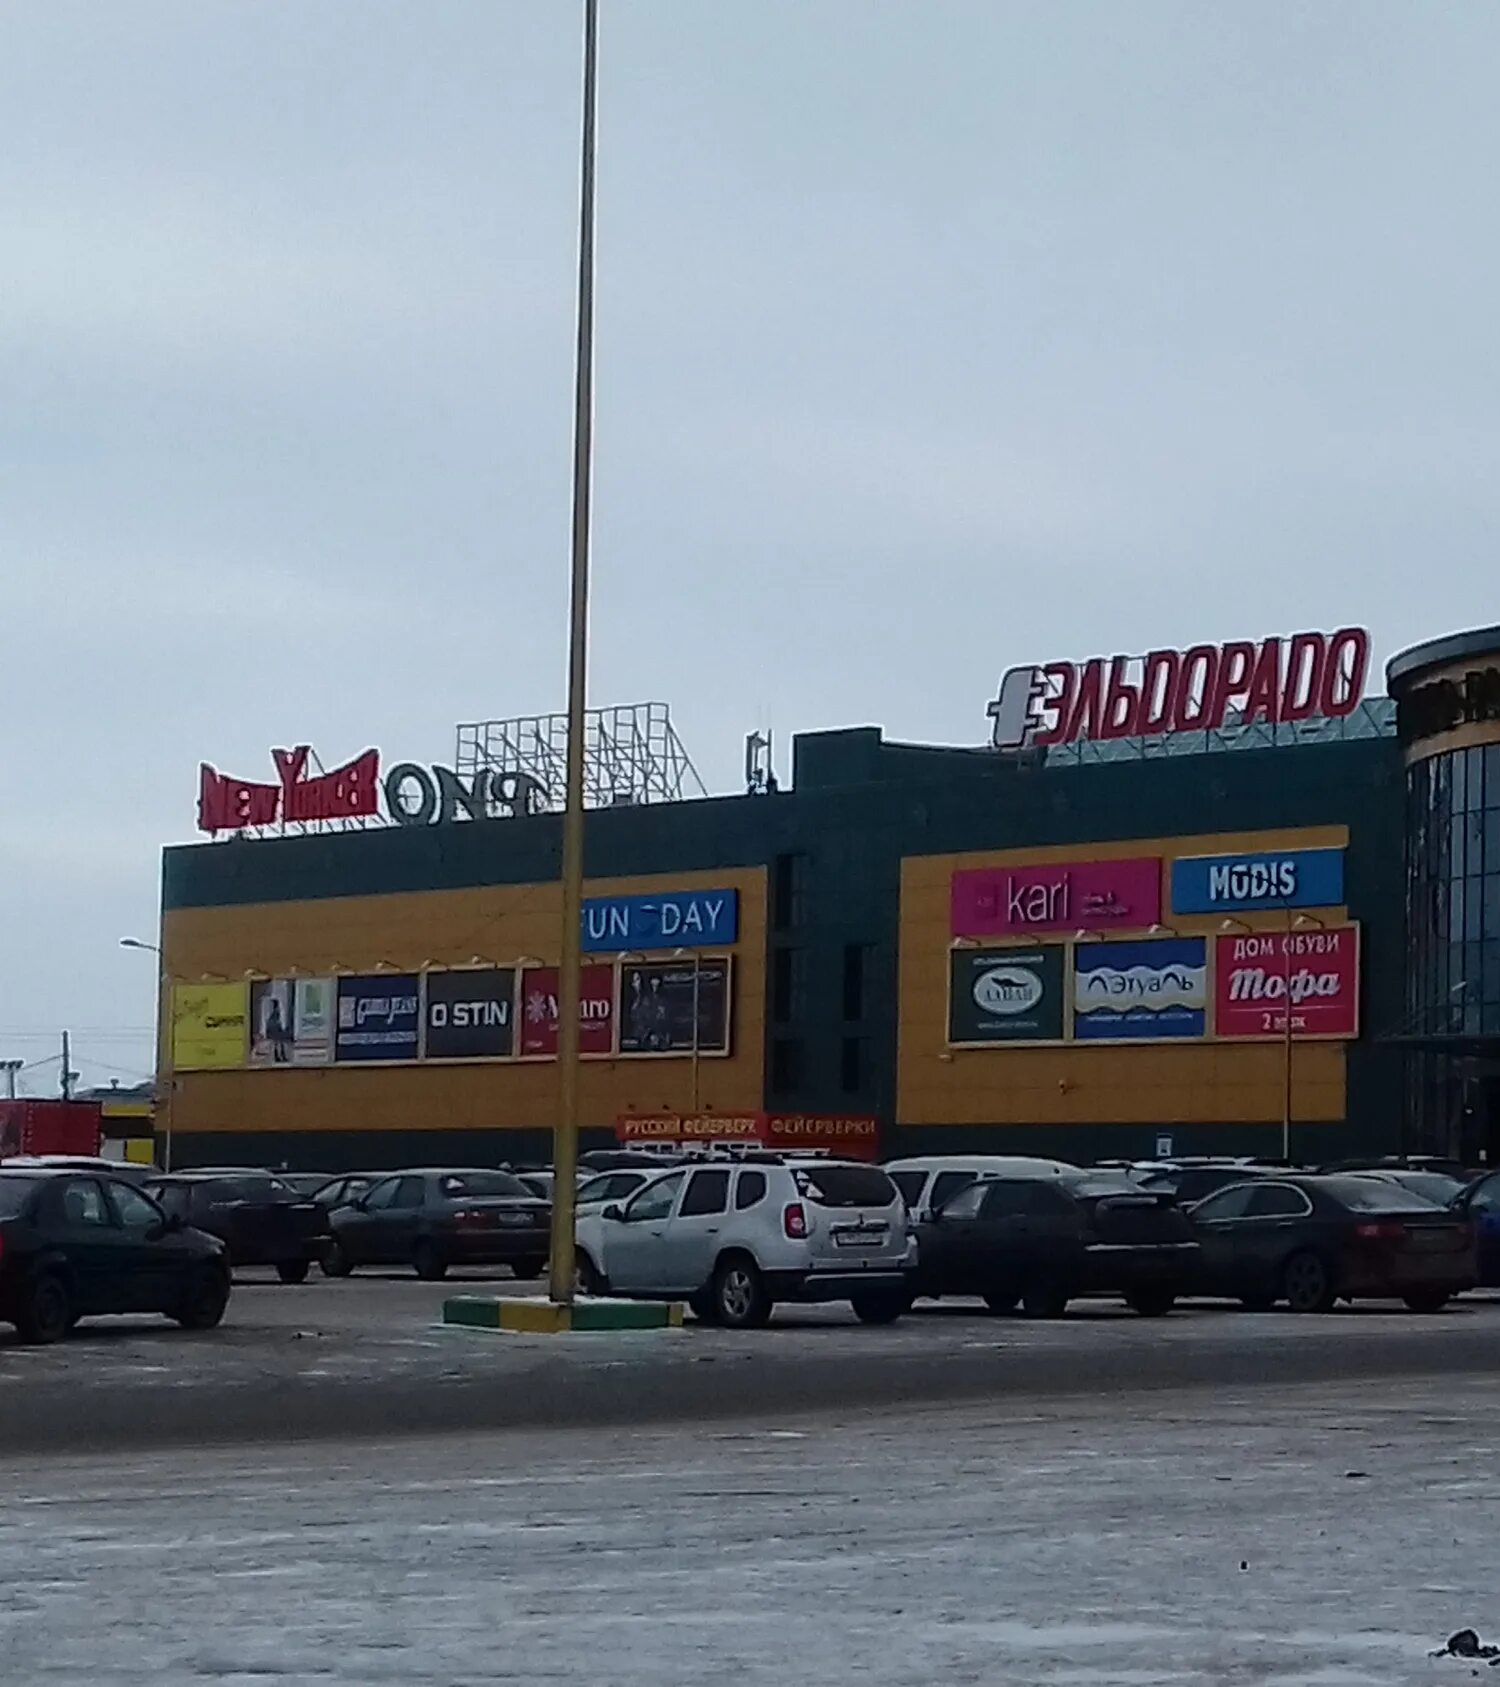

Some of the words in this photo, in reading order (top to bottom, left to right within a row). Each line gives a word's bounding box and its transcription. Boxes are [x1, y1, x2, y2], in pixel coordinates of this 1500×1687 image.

[1008, 872, 1071, 923] kari
[662, 899, 724, 935] DAY
[1233, 937, 1274, 961] ДОМ
[1282, 934, 1340, 955] ОБУВИ
[1261, 1012, 1272, 1030] 2
